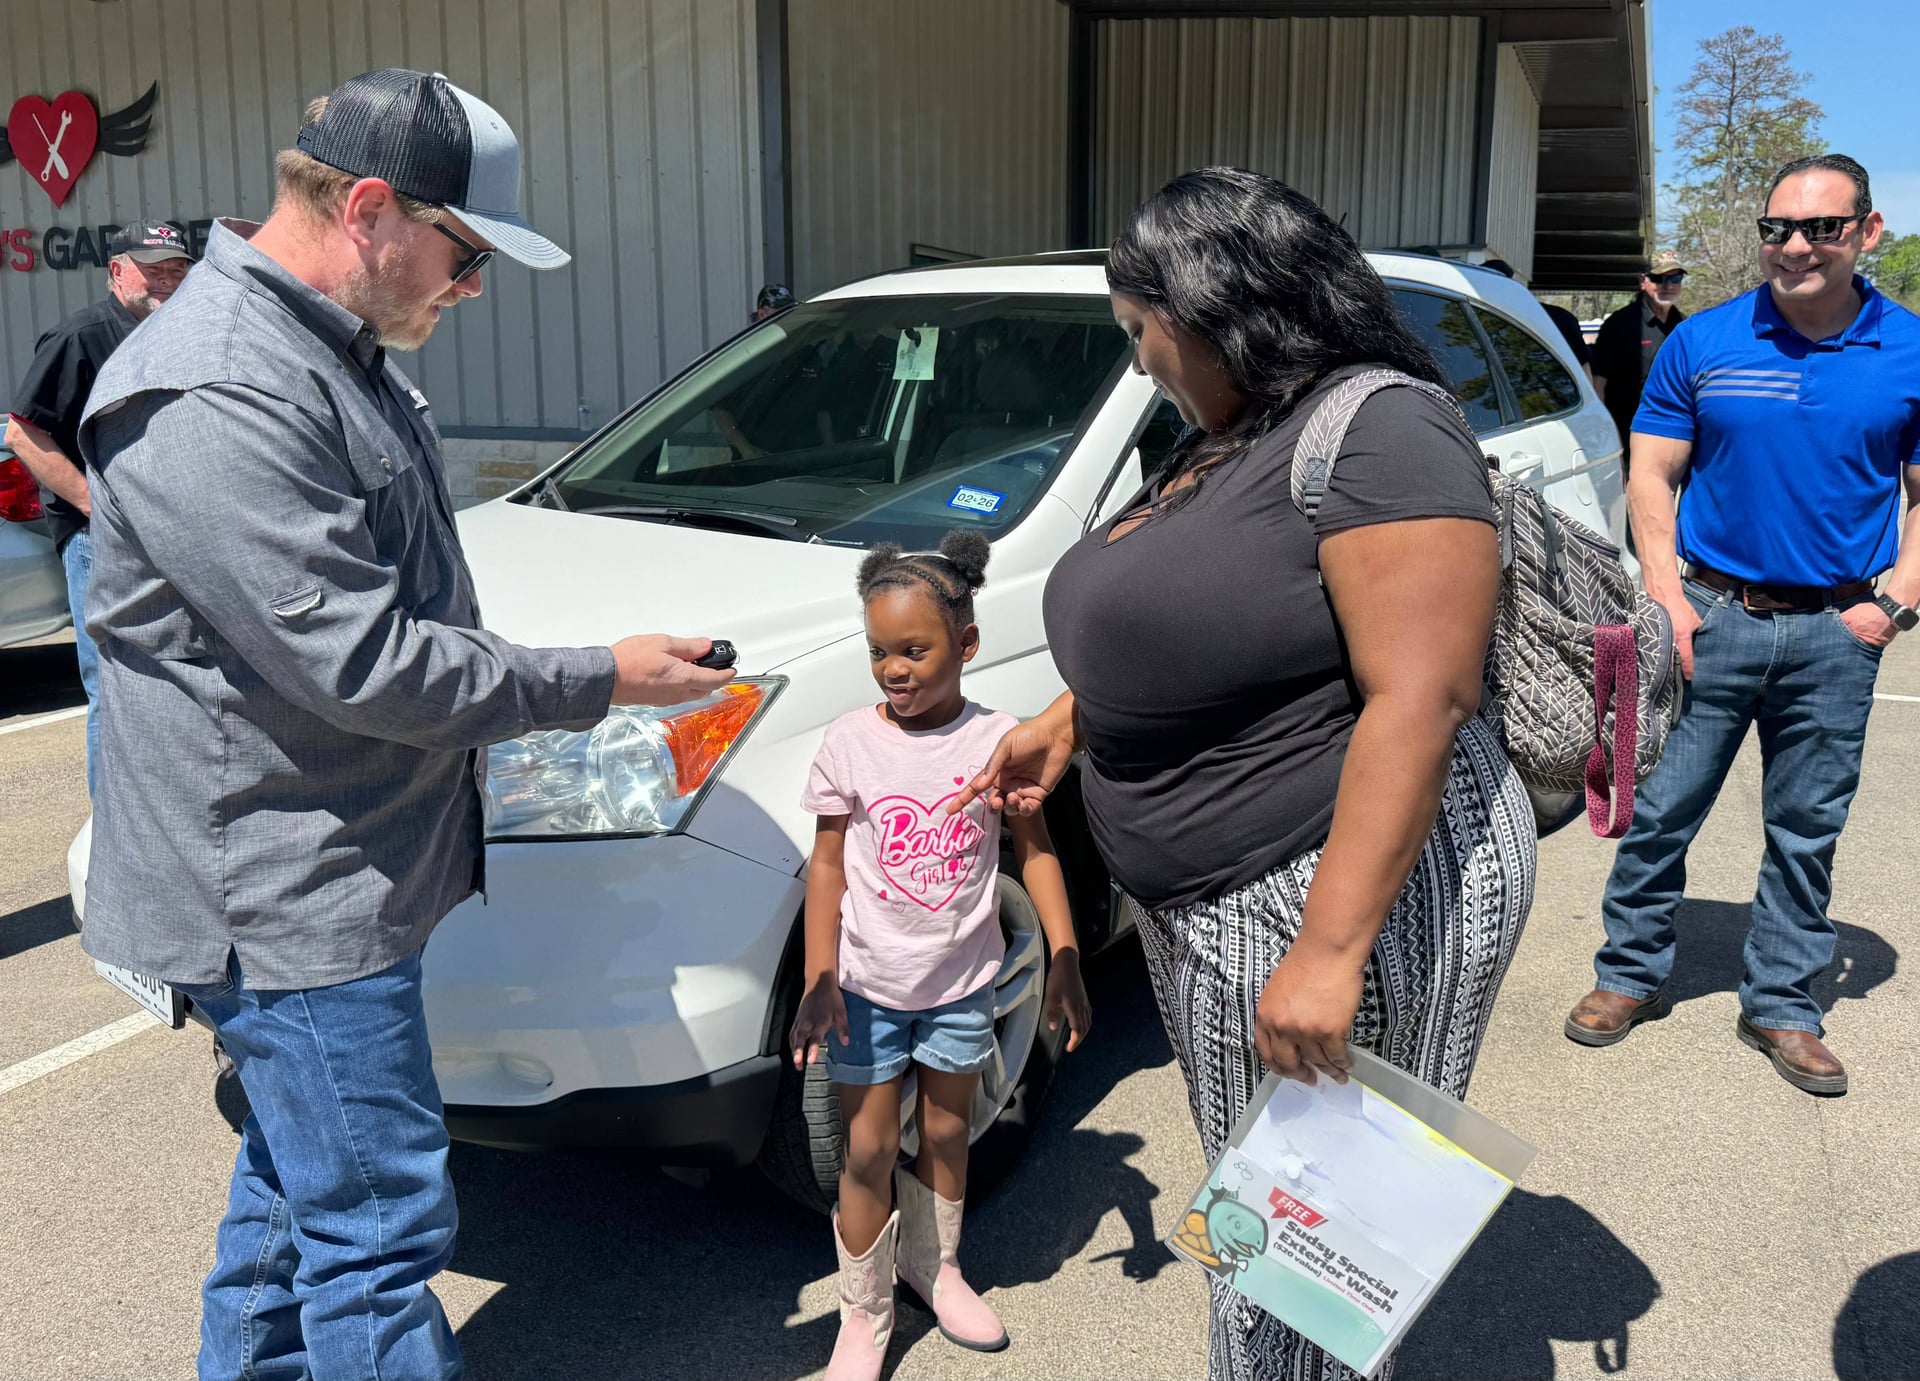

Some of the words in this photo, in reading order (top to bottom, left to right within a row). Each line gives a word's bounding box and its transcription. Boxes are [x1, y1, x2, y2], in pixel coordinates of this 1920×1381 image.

[0, 229, 35, 272] 'S
[880, 806, 981, 866] Barbie
[1276, 1195, 1312, 1221] FREE
[1273, 1241, 1294, 1257] ($20
[1294, 1256, 1322, 1277] value)
[1278, 1230, 1345, 1280] Exterior
[1346, 1275, 1393, 1314] Wash
[1285, 1220, 1336, 1260] Sudsy
[1337, 1255, 1398, 1300] Special
